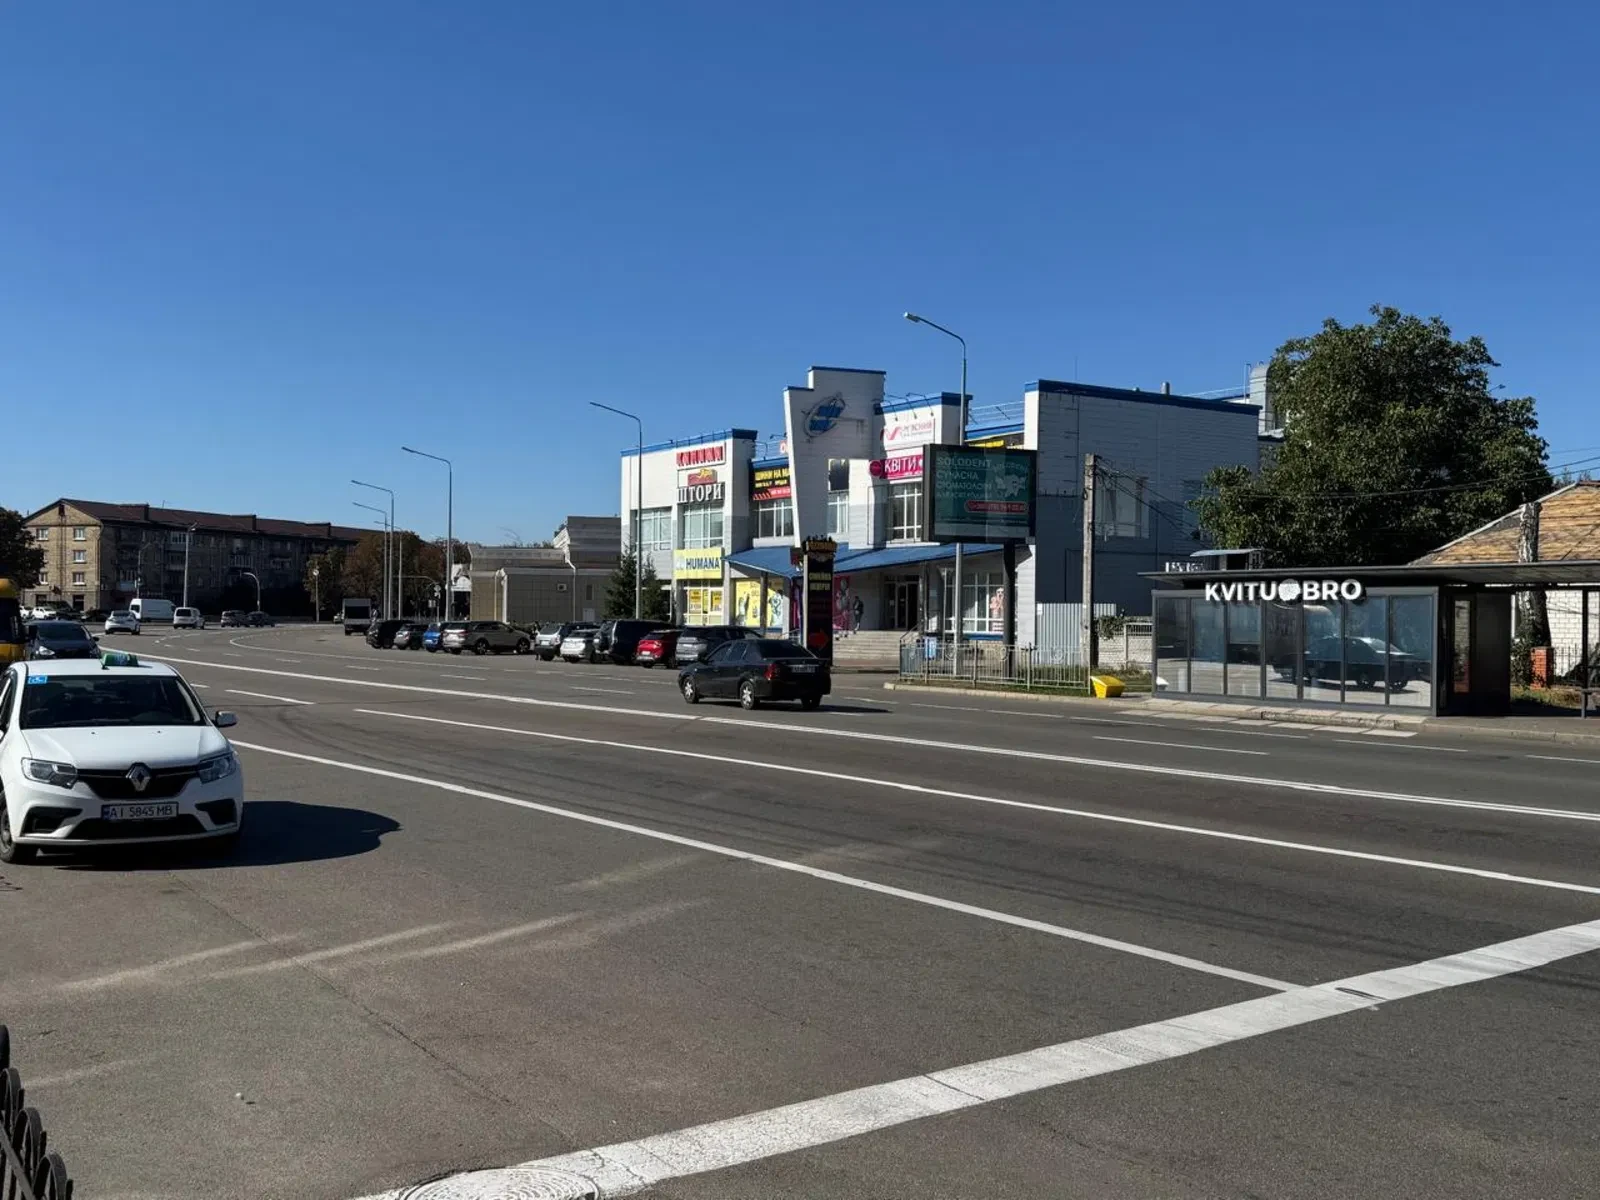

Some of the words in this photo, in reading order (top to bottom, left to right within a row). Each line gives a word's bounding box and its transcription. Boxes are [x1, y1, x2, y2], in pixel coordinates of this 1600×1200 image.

[885, 457, 916, 472] КВІТИ
[936, 457, 992, 468] SOLODENT
[677, 483, 722, 503] ШТОРИ
[686, 557, 720, 570] HUMANA
[1205, 582, 1276, 601] KVITU
[1303, 579, 1362, 600] BRO
[110, 807, 123, 818] AI
[129, 806, 154, 817] 5845
[156, 804, 172, 816] MB
